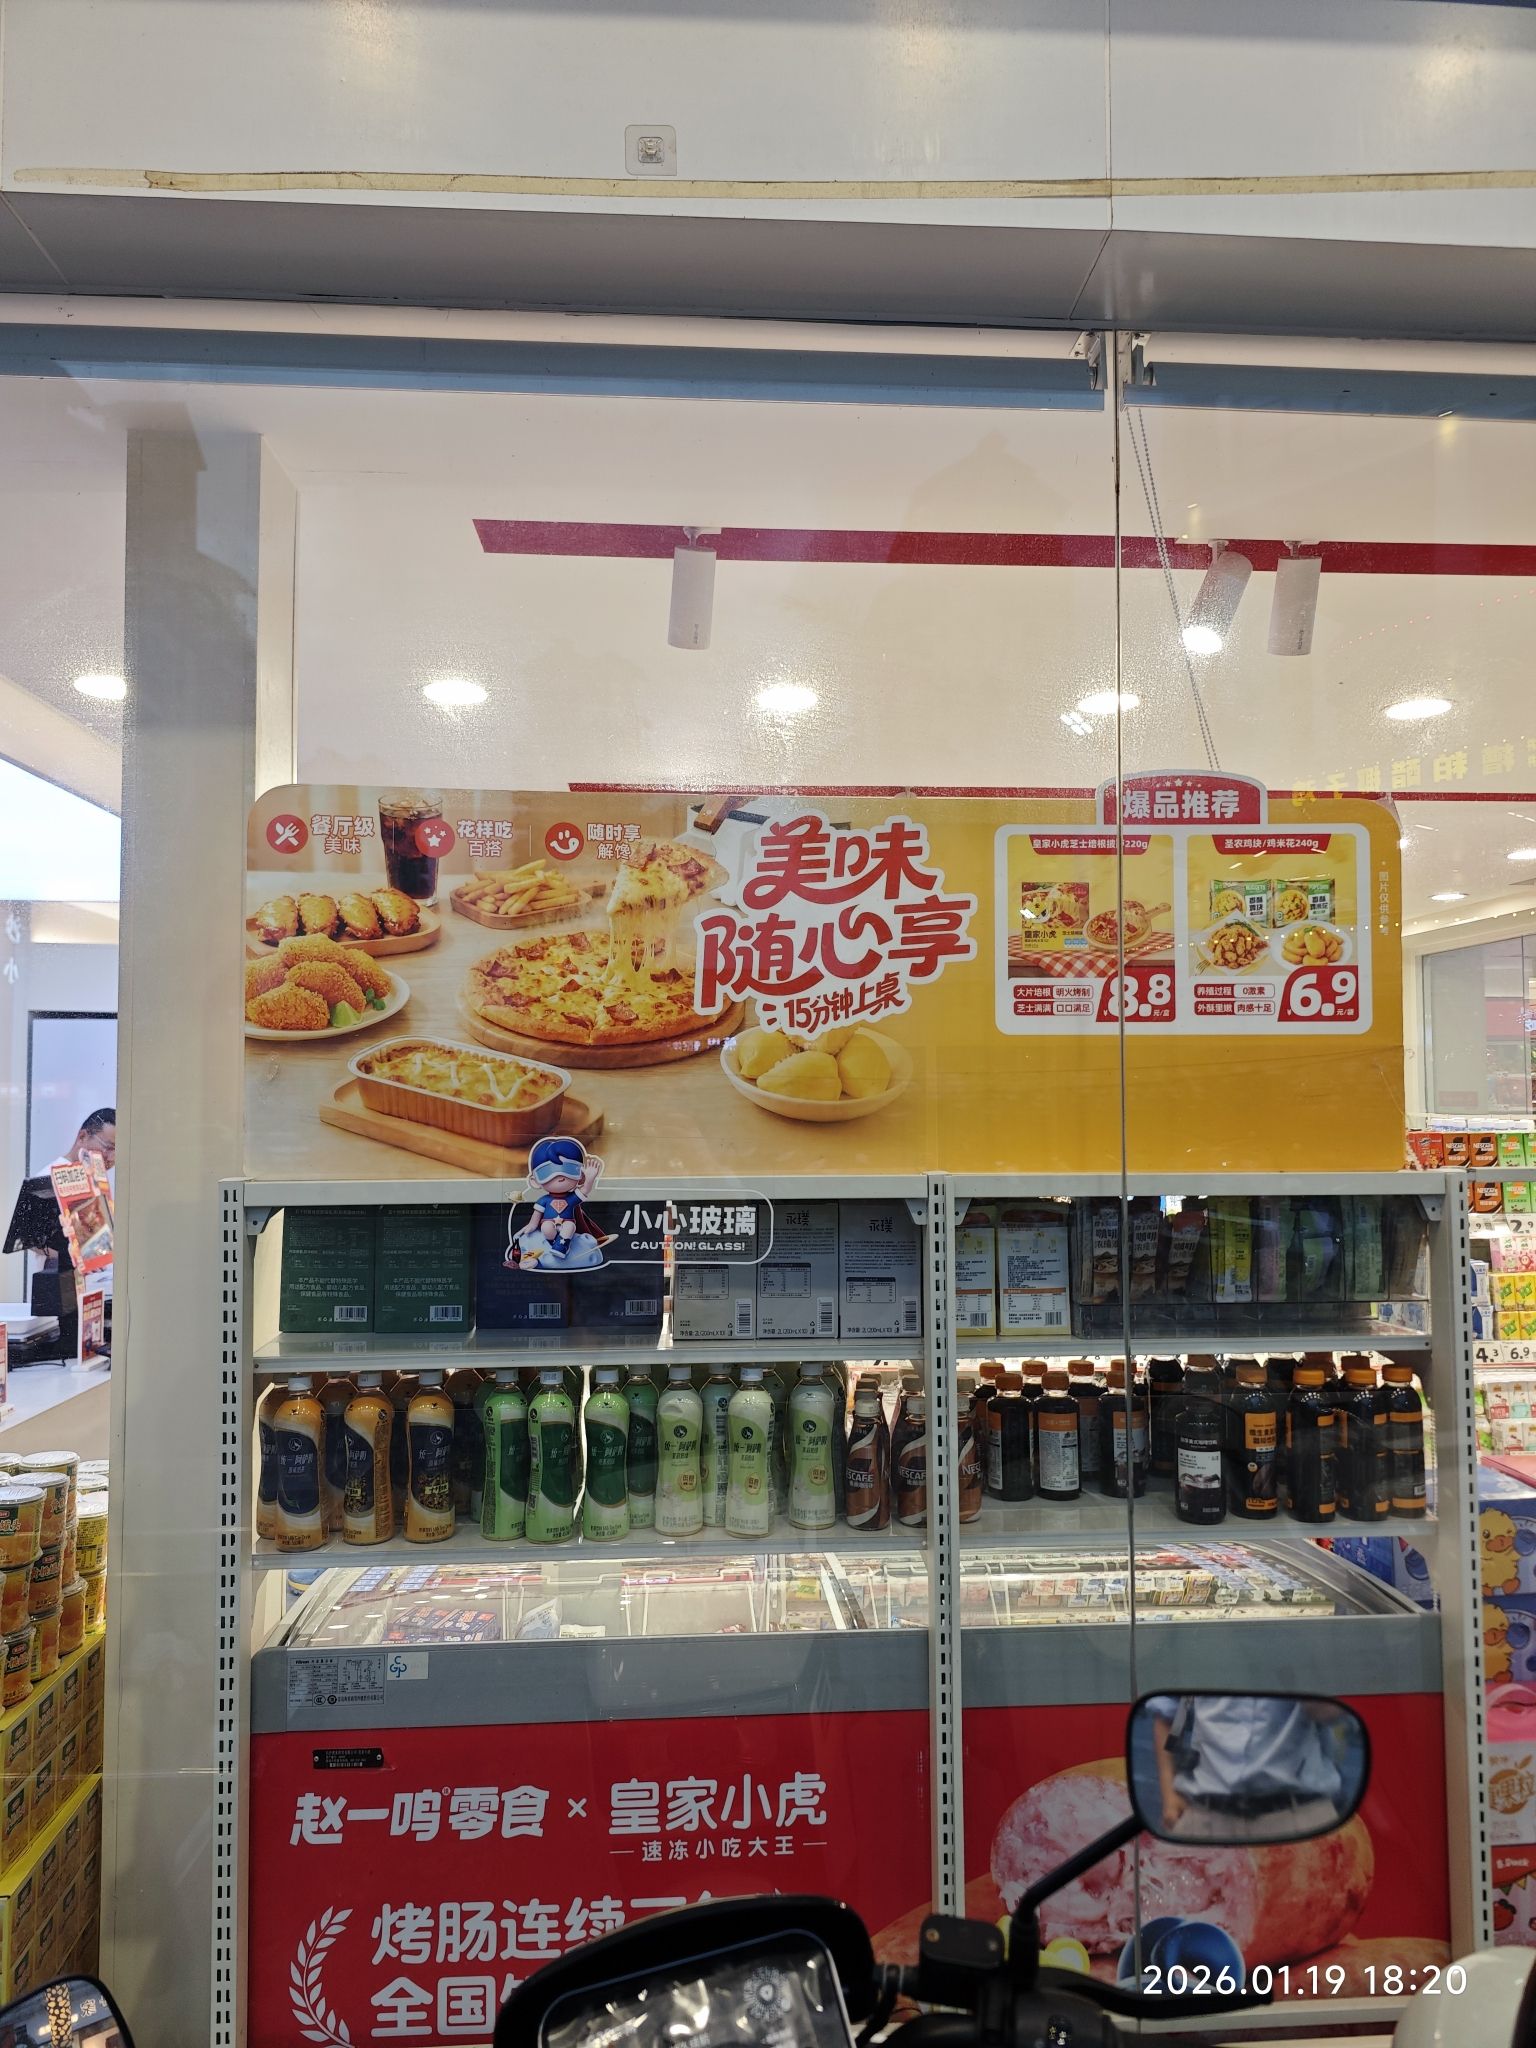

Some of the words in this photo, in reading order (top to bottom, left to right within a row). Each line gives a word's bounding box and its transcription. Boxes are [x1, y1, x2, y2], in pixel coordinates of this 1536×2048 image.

[1122, 789, 1240, 819] 爆品推荐
[311, 814, 375, 838] 餐厅级
[457, 820, 513, 840] 花样吃
[587, 823, 641, 843] 随时享
[324, 838, 361, 854] 美味
[468, 840, 503, 857] 百搭
[597, 843, 632, 861] 解馋
[1032, 839, 1148, 850] 皇家小虎芝士培根披220g
[1224, 838, 1319, 849] 圣农鸡块/鸡米花240g
[742, 815, 938, 910] 美味
[700, 895, 971, 1009] 随心享
[1016, 988, 1051, 997] 大片培根
[1056, 988, 1090, 997] 明火烤制
[1197, 986, 1232, 996] 养殖过程
[1242, 986, 1265, 995] 0激素
[783, 971, 906, 1033] 15分钟上桌
[1016, 1004, 1051, 1013] 芝士满满
[1056, 1004, 1090, 1013] 口口满足
[1197, 1003, 1232, 1013] 外酥里嫩
[1237, 1003, 1272, 1012] 肉感十足
[619, 1203, 757, 1236] 小心玻璃
[1510, 1219, 1534, 1234] 2.9
[630, 1241, 696, 1250] CAUTION!
[698, 1241, 746, 1251] GLASS!
[1475, 1347, 1499, 1363] 4.3
[1510, 1346, 1530, 1360] 6.9
[289, 1784, 550, 1846] 赵一鸣零食
[608, 1771, 828, 1835] 皇家小虎
[641, 1835, 795, 1862] 速冻小吃大王
[371, 1890, 716, 1965] 烤肠连续
[371, 1972, 525, 2038] 全国
